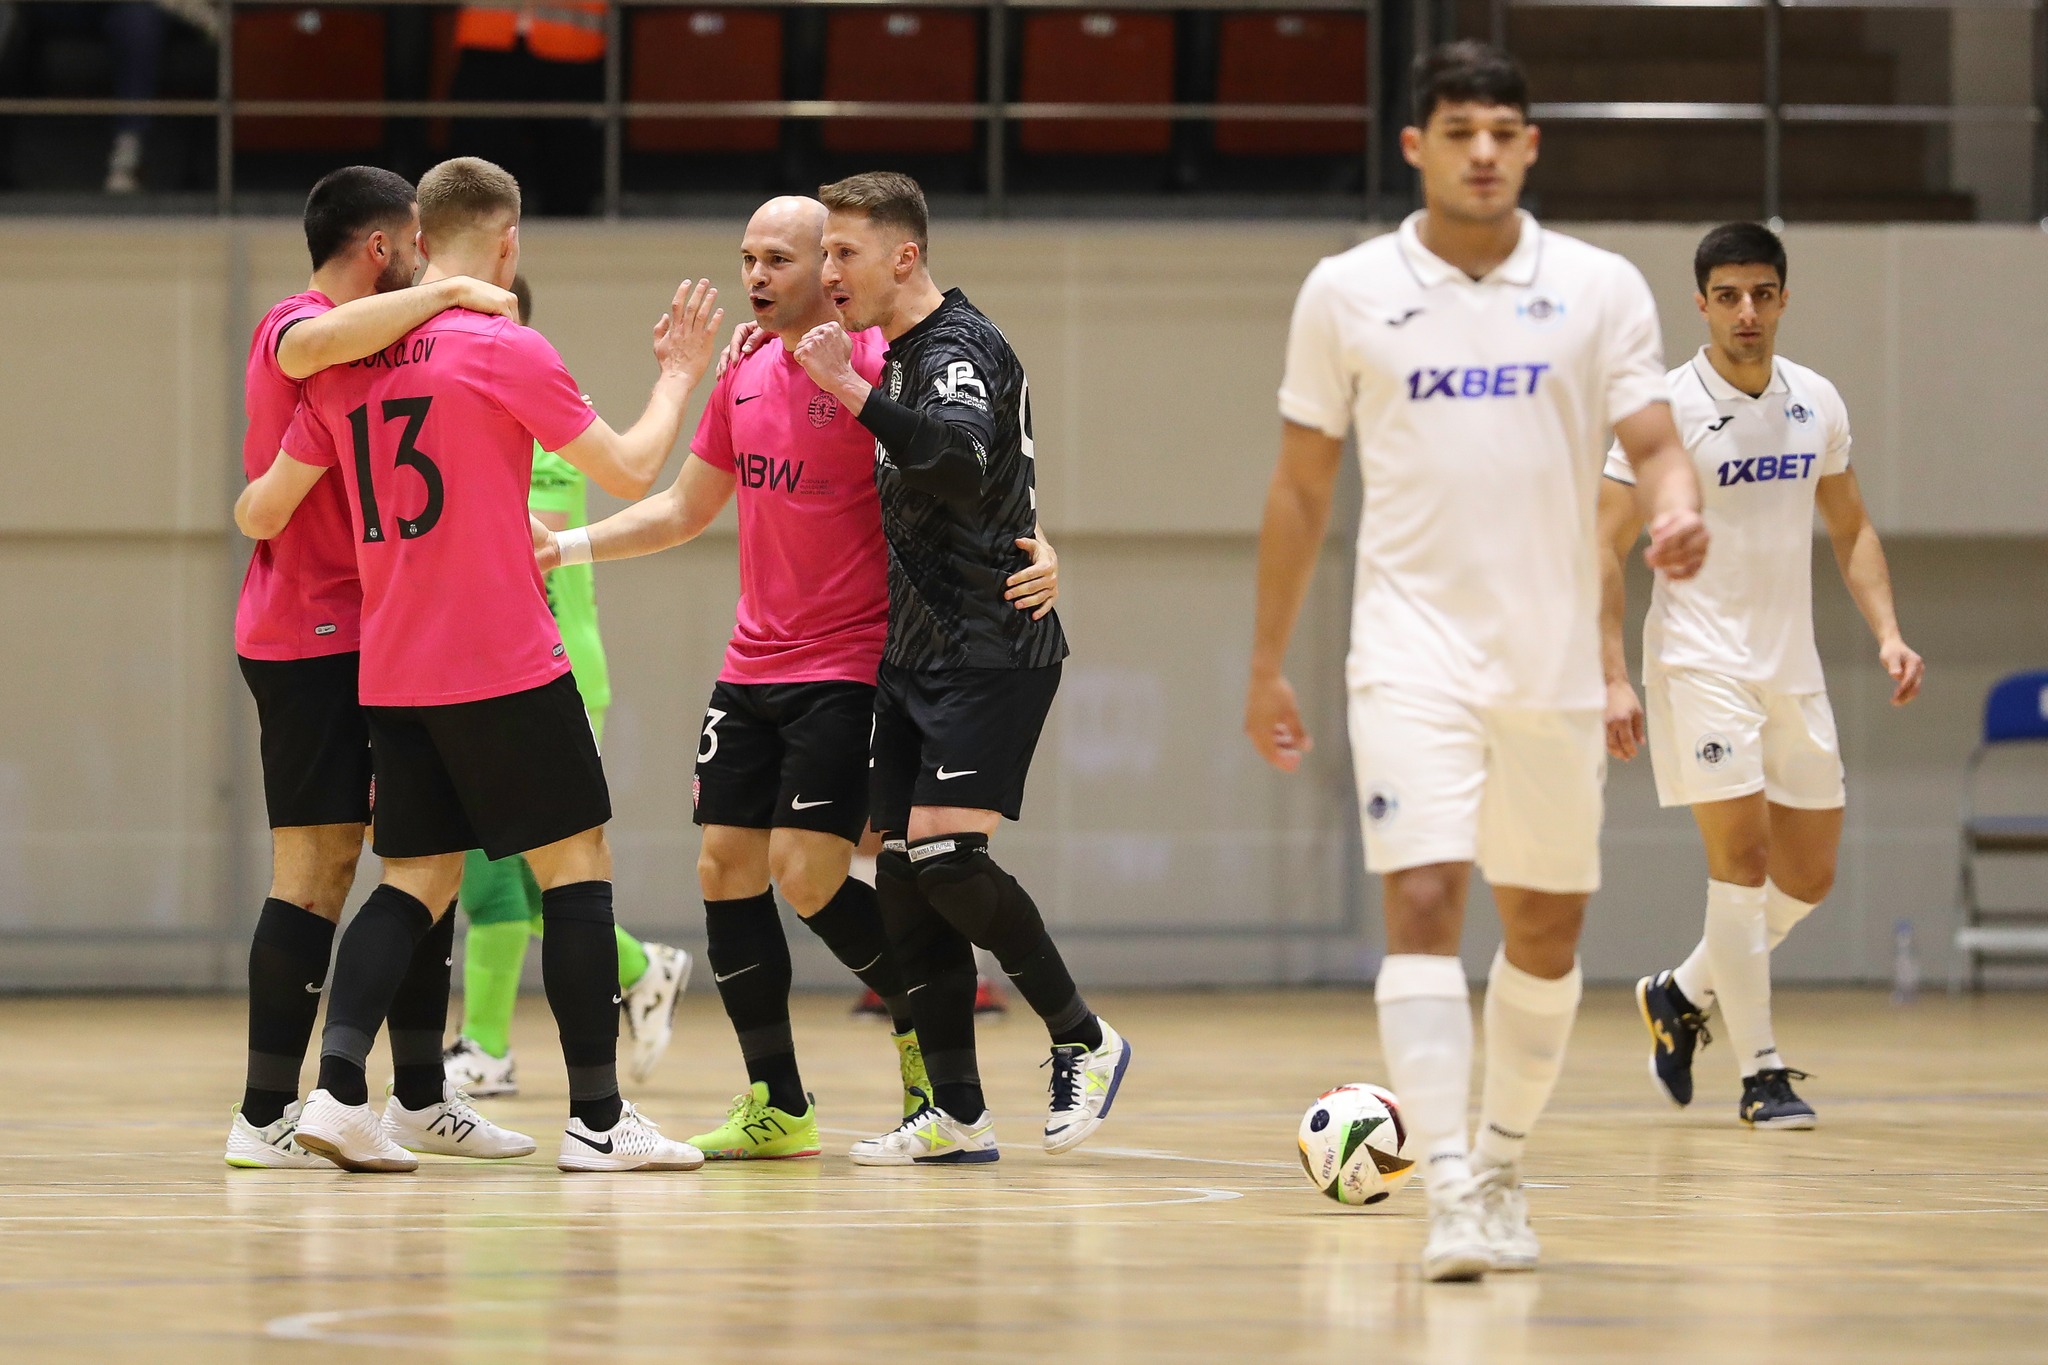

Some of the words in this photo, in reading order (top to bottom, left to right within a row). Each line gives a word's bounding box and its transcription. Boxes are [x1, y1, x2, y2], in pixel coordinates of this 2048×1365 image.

[1407, 363, 1549, 400] 1XBET
[345, 395, 444, 543] 13
[734, 452, 805, 494] MBW
[1717, 452, 1816, 487] 1XBET
[696, 706, 728, 764] 3
